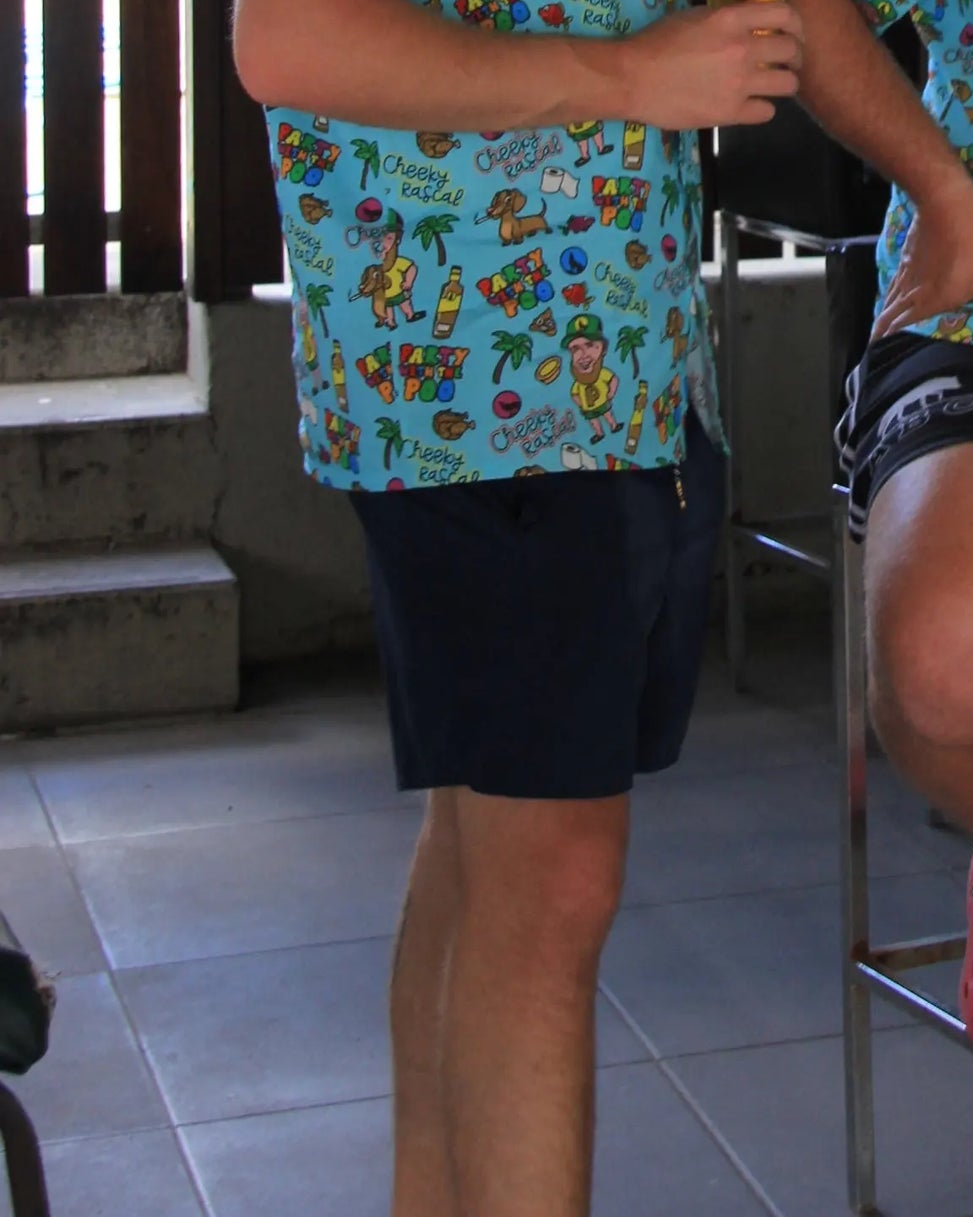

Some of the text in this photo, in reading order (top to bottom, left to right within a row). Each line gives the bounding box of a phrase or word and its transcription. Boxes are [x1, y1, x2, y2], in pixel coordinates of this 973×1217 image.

[279, 122, 341, 162] PARTY
[281, 156, 324, 186] POO
[384, 154, 449, 188] Cheeky
[476, 248, 544, 297] PARTY
[504, 280, 555, 318] POO
[399, 343, 470, 367] PARTY
[403, 377, 456, 402] POO
